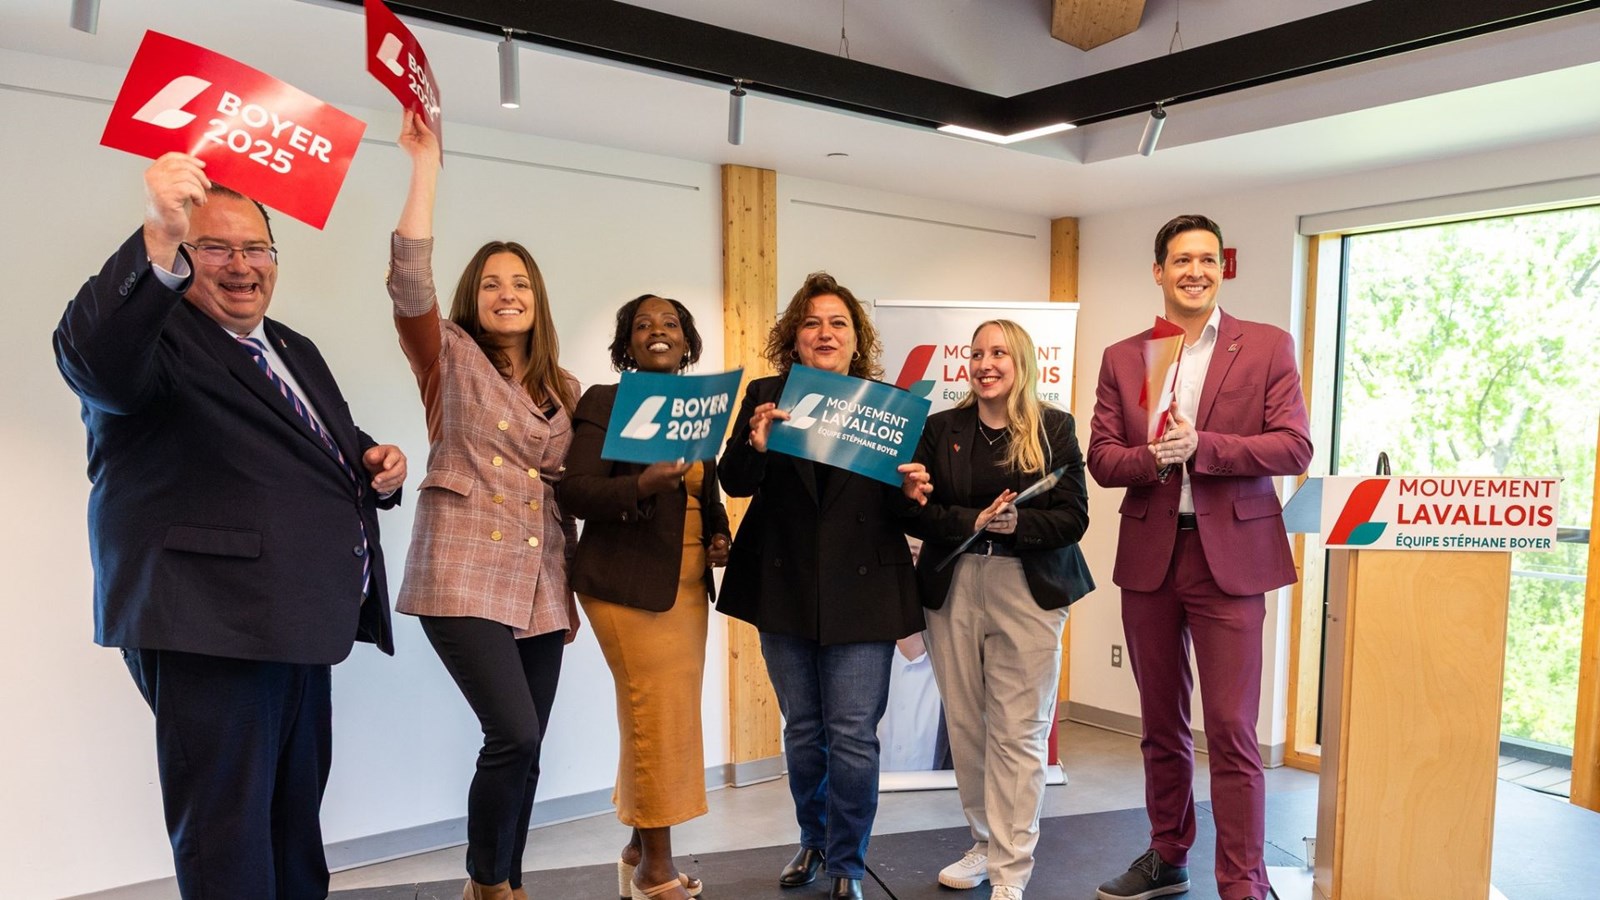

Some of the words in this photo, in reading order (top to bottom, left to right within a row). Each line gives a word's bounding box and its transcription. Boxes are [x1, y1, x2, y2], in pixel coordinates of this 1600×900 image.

[216, 90, 333, 164] BOYER
[203, 118, 295, 174] 2025
[671, 392, 729, 418] BOYER
[826, 397, 909, 429] MOUVEMENT
[665, 417, 712, 441] 2025
[821, 409, 904, 445] LAVALLOIS
[841, 433, 877, 450] STÉPHANE
[876, 443, 898, 457] BOYER
[1399, 478, 1556, 498] MOUVEMENT
[1397, 503, 1553, 528] LAVALLOIS
[1395, 532, 1440, 549] ÉQUIPE
[1442, 533, 1507, 549] STÉPHANE
[1509, 538, 1551, 549] BOYER
